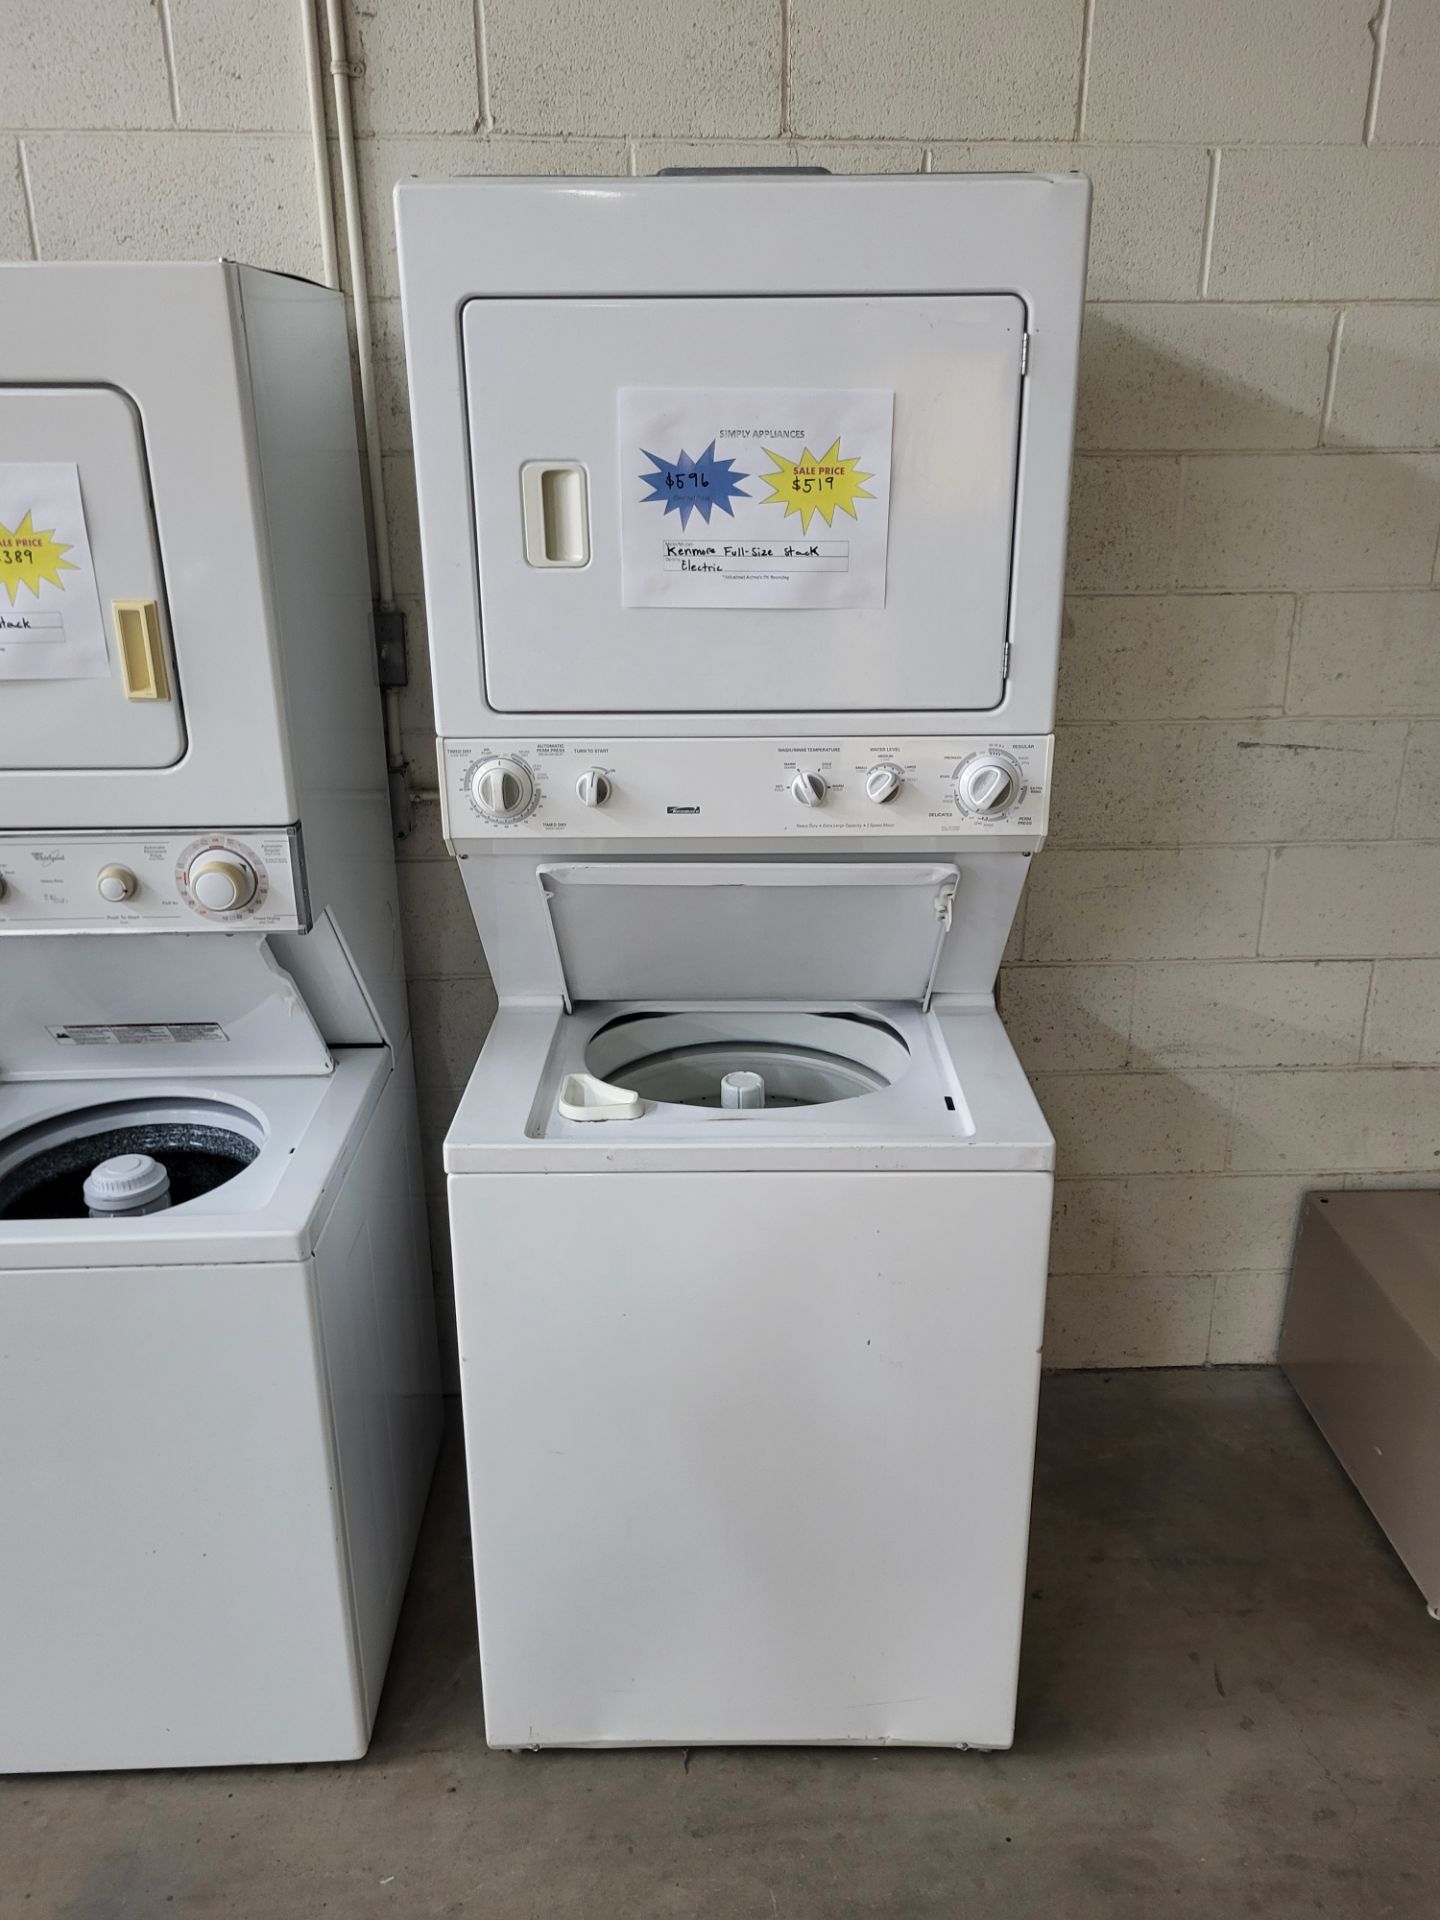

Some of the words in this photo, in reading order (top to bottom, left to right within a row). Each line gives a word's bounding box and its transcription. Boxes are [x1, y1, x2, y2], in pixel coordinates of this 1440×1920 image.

[719, 429, 750, 439] SIMPLY
[752, 429, 805, 439] APPLIANCES
[793, 466, 817, 475] SALE
[818, 466, 845, 475] PRICE
[665, 472, 709, 490] $596
[791, 476, 834, 493] $519
[15, 538, 43, 547] PRICE
[0, 549, 33, 565] 389
[667, 545, 716, 557] Kenmore
[681, 560, 723, 572] Electric
[0, 616, 31, 629] tack
